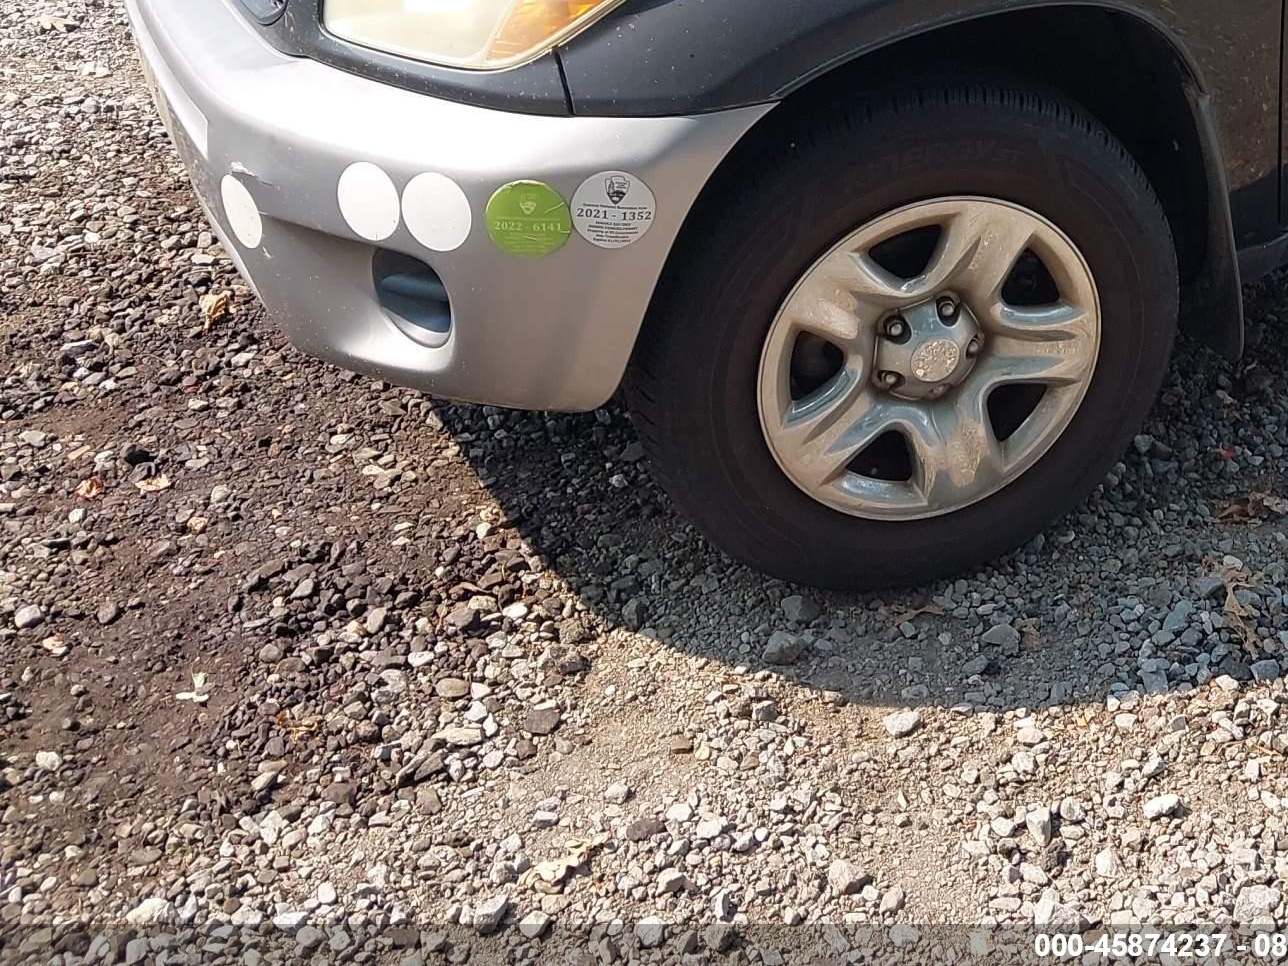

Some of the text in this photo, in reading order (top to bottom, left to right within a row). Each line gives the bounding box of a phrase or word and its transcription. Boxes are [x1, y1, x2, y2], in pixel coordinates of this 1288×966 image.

[576, 207, 609, 220] 2021
[622, 211, 652, 222] 1352
[494, 221, 523, 232] 2022
[532, 222, 561, 233] 6141
